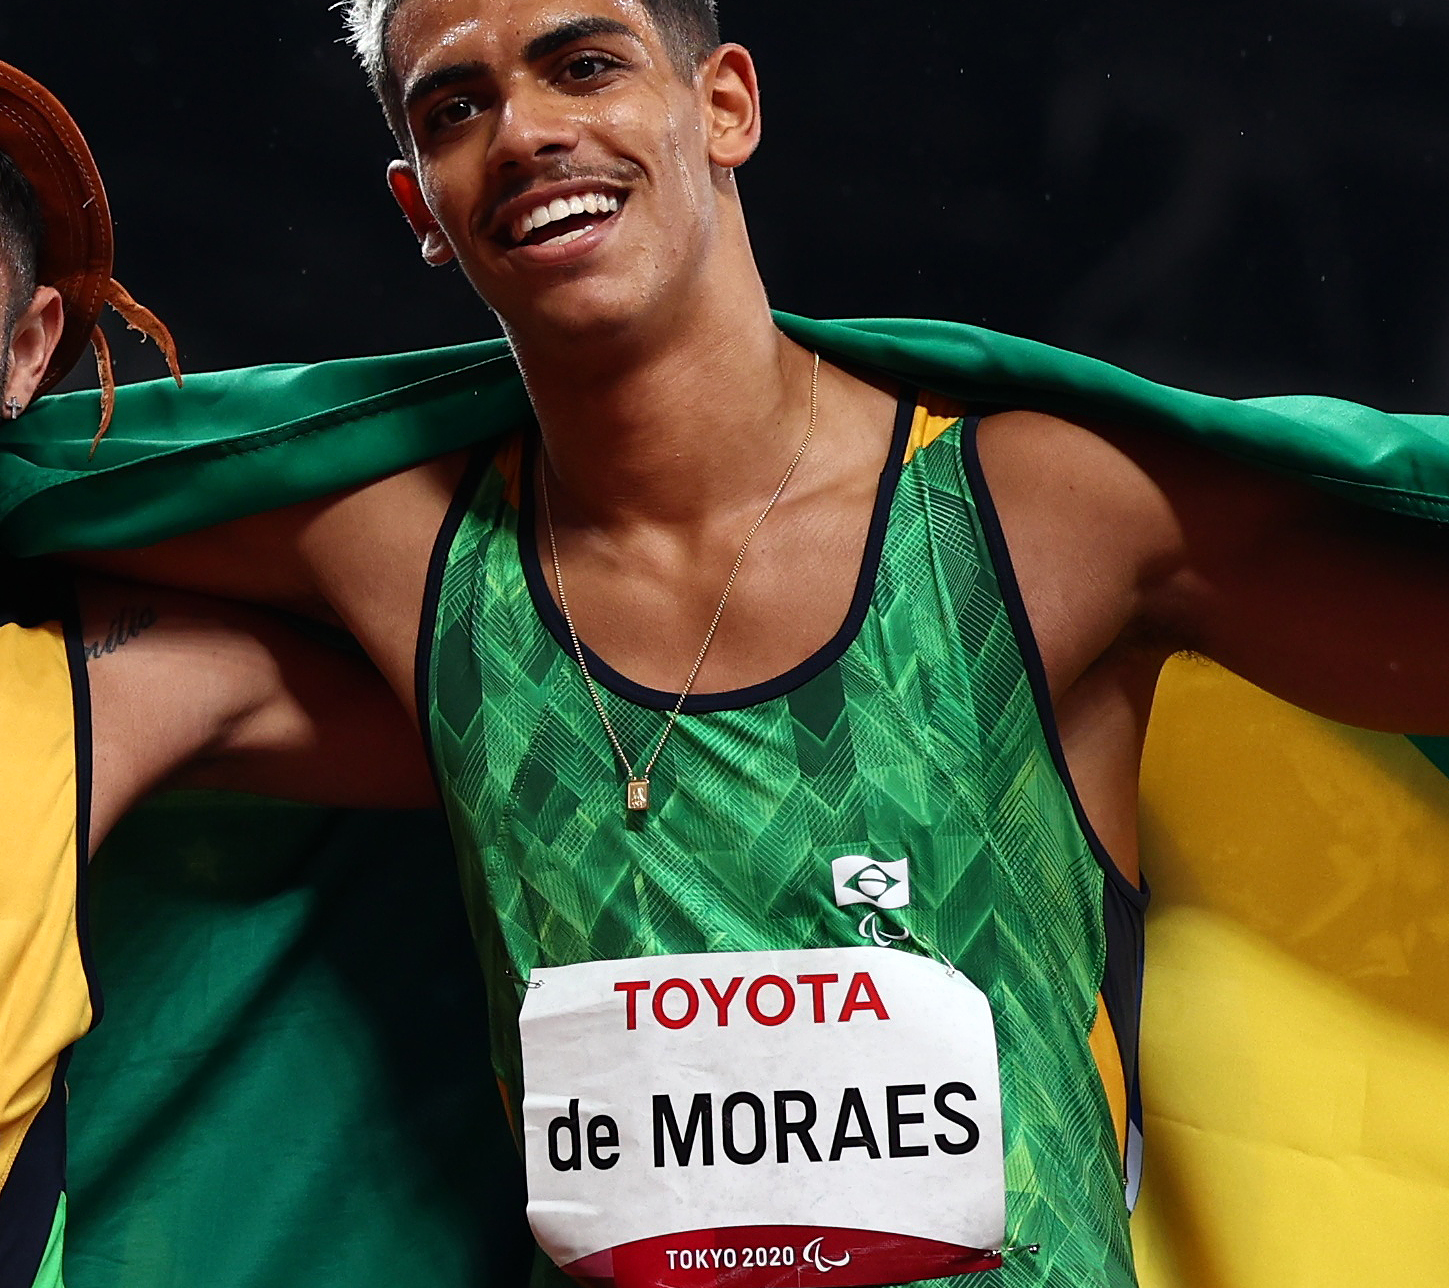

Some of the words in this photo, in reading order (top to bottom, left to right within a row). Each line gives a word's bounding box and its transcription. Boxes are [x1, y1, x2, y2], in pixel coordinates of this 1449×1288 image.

[615, 971, 890, 1031] TOYOTA
[546, 1098, 621, 1172] de
[651, 1080, 981, 1169] MORAES
[664, 1247, 738, 1271] TOKYO
[741, 1245, 796, 1269] 2020
